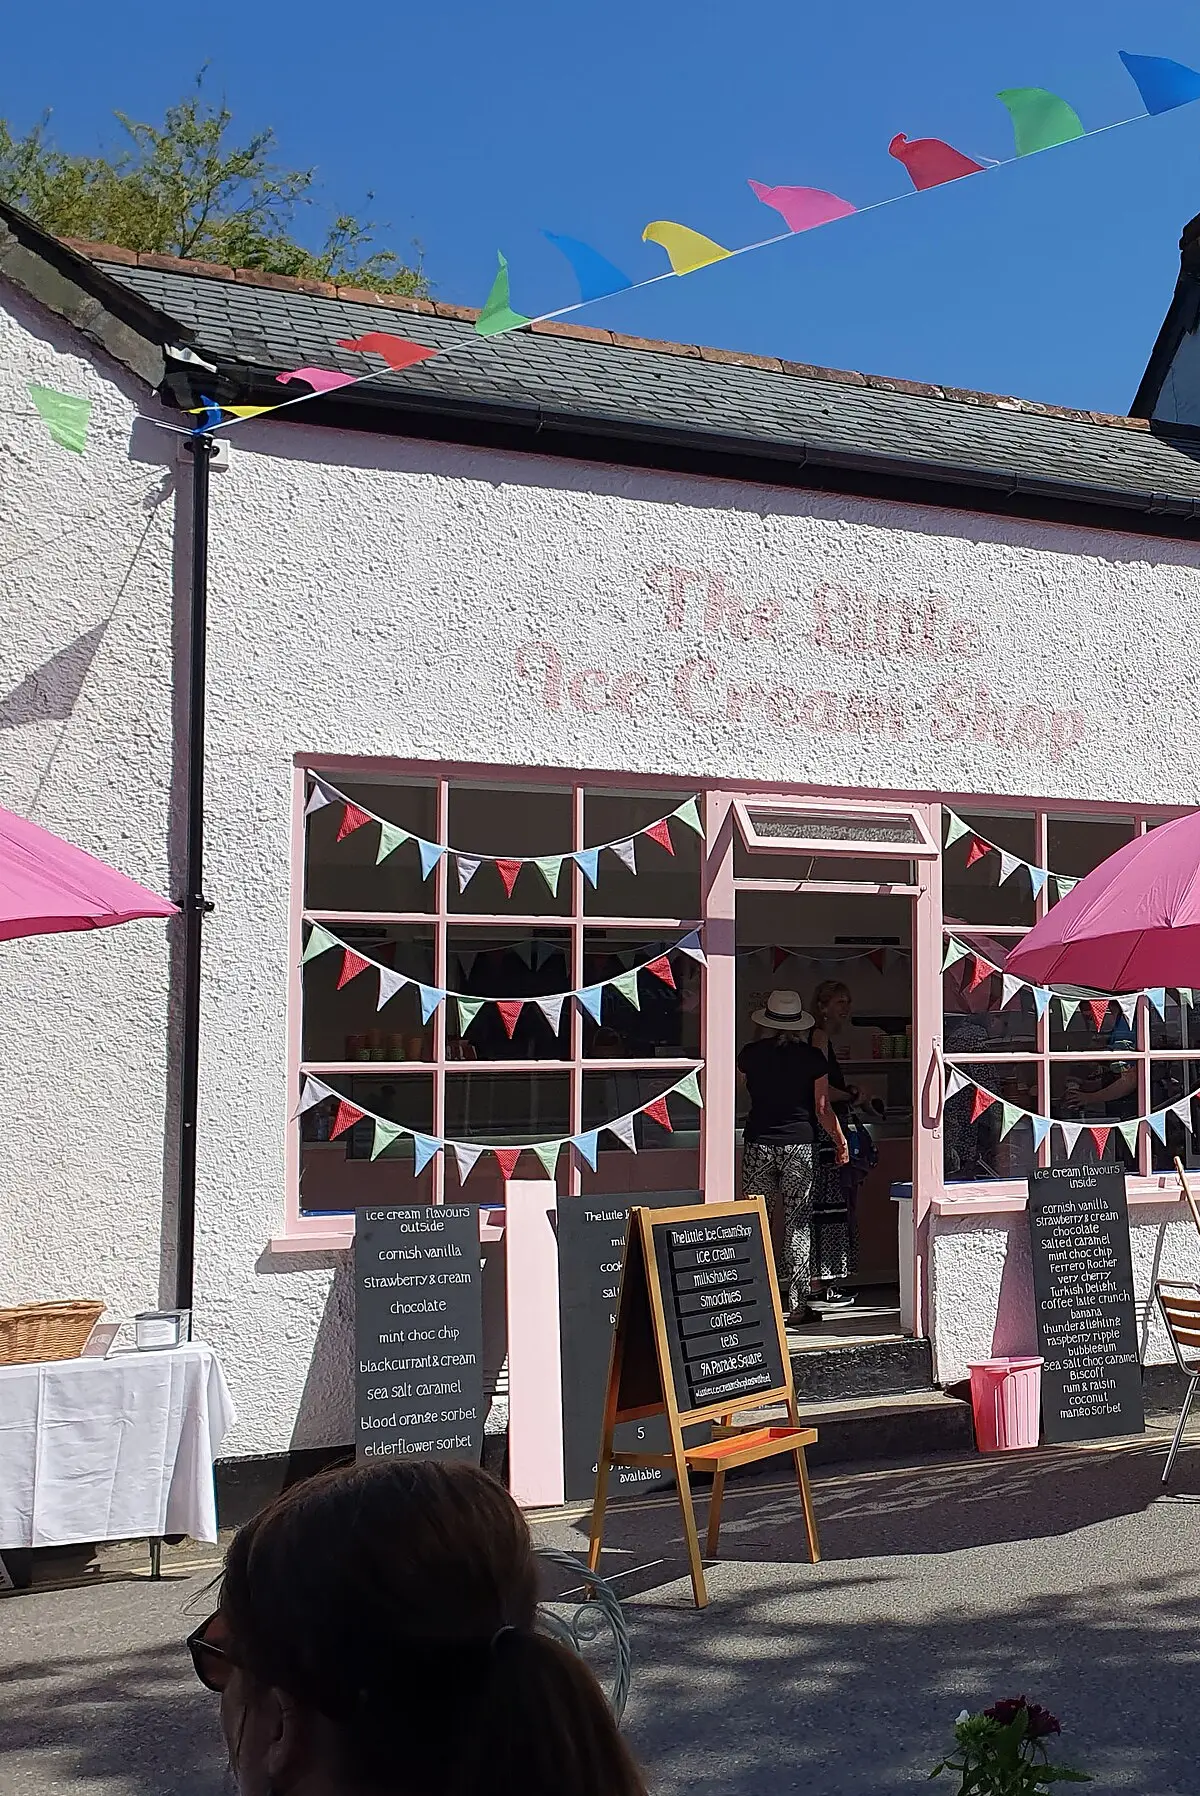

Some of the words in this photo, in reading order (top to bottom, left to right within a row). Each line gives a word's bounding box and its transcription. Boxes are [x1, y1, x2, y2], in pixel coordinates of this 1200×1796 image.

[648, 565, 783, 640] The
[808, 582, 979, 661] Little
[516, 641, 650, 712] Ice
[673, 656, 905, 741] Cream
[929, 680, 1086, 764] Shop
[1034, 1170, 1049, 1180] ice
[1051, 1167, 1080, 1178] cream
[1082, 1164, 1120, 1176] flavours
[1069, 1177, 1097, 1188] inside
[1042, 1200, 1076, 1214] cornish
[1078, 1197, 1109, 1211] vanilla
[366, 1210, 384, 1220] ice
[386, 1209, 420, 1219] cream
[425, 1207, 470, 1219] flavours
[1084, 1214, 1089, 1222] &
[1090, 1211, 1119, 1221] cream
[400, 1220, 444, 1233] outside
[704, 1227, 717, 1240] Ice
[1053, 1223, 1100, 1237] chocolate
[1074, 1232, 1111, 1246] caramel
[379, 1245, 422, 1260] cornish
[424, 1244, 462, 1258] vanilla
[696, 1250, 710, 1264] ice
[712, 1247, 736, 1260] cream
[1048, 1249, 1067, 1261] mint
[1069, 1248, 1092, 1259] choc
[1093, 1246, 1113, 1259] chip
[1050, 1262, 1085, 1273] Ferrero
[1086, 1258, 1118, 1270] Rocher
[429, 1274, 436, 1285] &
[437, 1273, 471, 1284] cream
[693, 1269, 738, 1287] milkshakes
[1057, 1274, 1079, 1284] very
[1081, 1270, 1111, 1282] cherry
[1050, 1283, 1084, 1297] Turkish
[1085, 1280, 1117, 1293] Delight
[700, 1289, 742, 1307] smoothies
[1041, 1297, 1073, 1310] coffee
[1076, 1295, 1096, 1306] latte
[1098, 1289, 1130, 1304] crunch
[390, 1299, 447, 1314] chocolate
[1070, 1307, 1103, 1319] banana
[710, 1311, 743, 1328] coffees
[379, 1330, 405, 1343] mint
[407, 1329, 435, 1341] choc
[437, 1325, 460, 1341] chip
[720, 1333, 739, 1348] teas
[1046, 1332, 1091, 1348] raspberry
[1092, 1329, 1120, 1344] ripple
[1068, 1342, 1117, 1356] bubblegum
[700, 1362, 712, 1377] 9A
[711, 1357, 738, 1375] Parade
[737, 1352, 763, 1368] Square
[1043, 1360, 1061, 1371] sea
[1082, 1356, 1104, 1367] choc
[1105, 1352, 1138, 1365] caramel
[1069, 1367, 1105, 1380] Biscoff
[367, 1387, 389, 1400] sea
[391, 1382, 412, 1398] salt
[416, 1379, 462, 1397] caramel
[1063, 1383, 1081, 1393] rum
[1081, 1382, 1088, 1392] &
[1090, 1378, 1116, 1391] raisin
[1069, 1391, 1108, 1406] coconut
[1060, 1406, 1091, 1419] mango
[1091, 1402, 1121, 1415] sorbet
[360, 1412, 397, 1430] blood
[399, 1411, 438, 1426] orange
[440, 1407, 477, 1422] sorbet
[637, 1426, 645, 1439] 5
[364, 1438, 435, 1457] elderflower
[436, 1434, 472, 1450] sorbet
[620, 1468, 661, 1483] available
